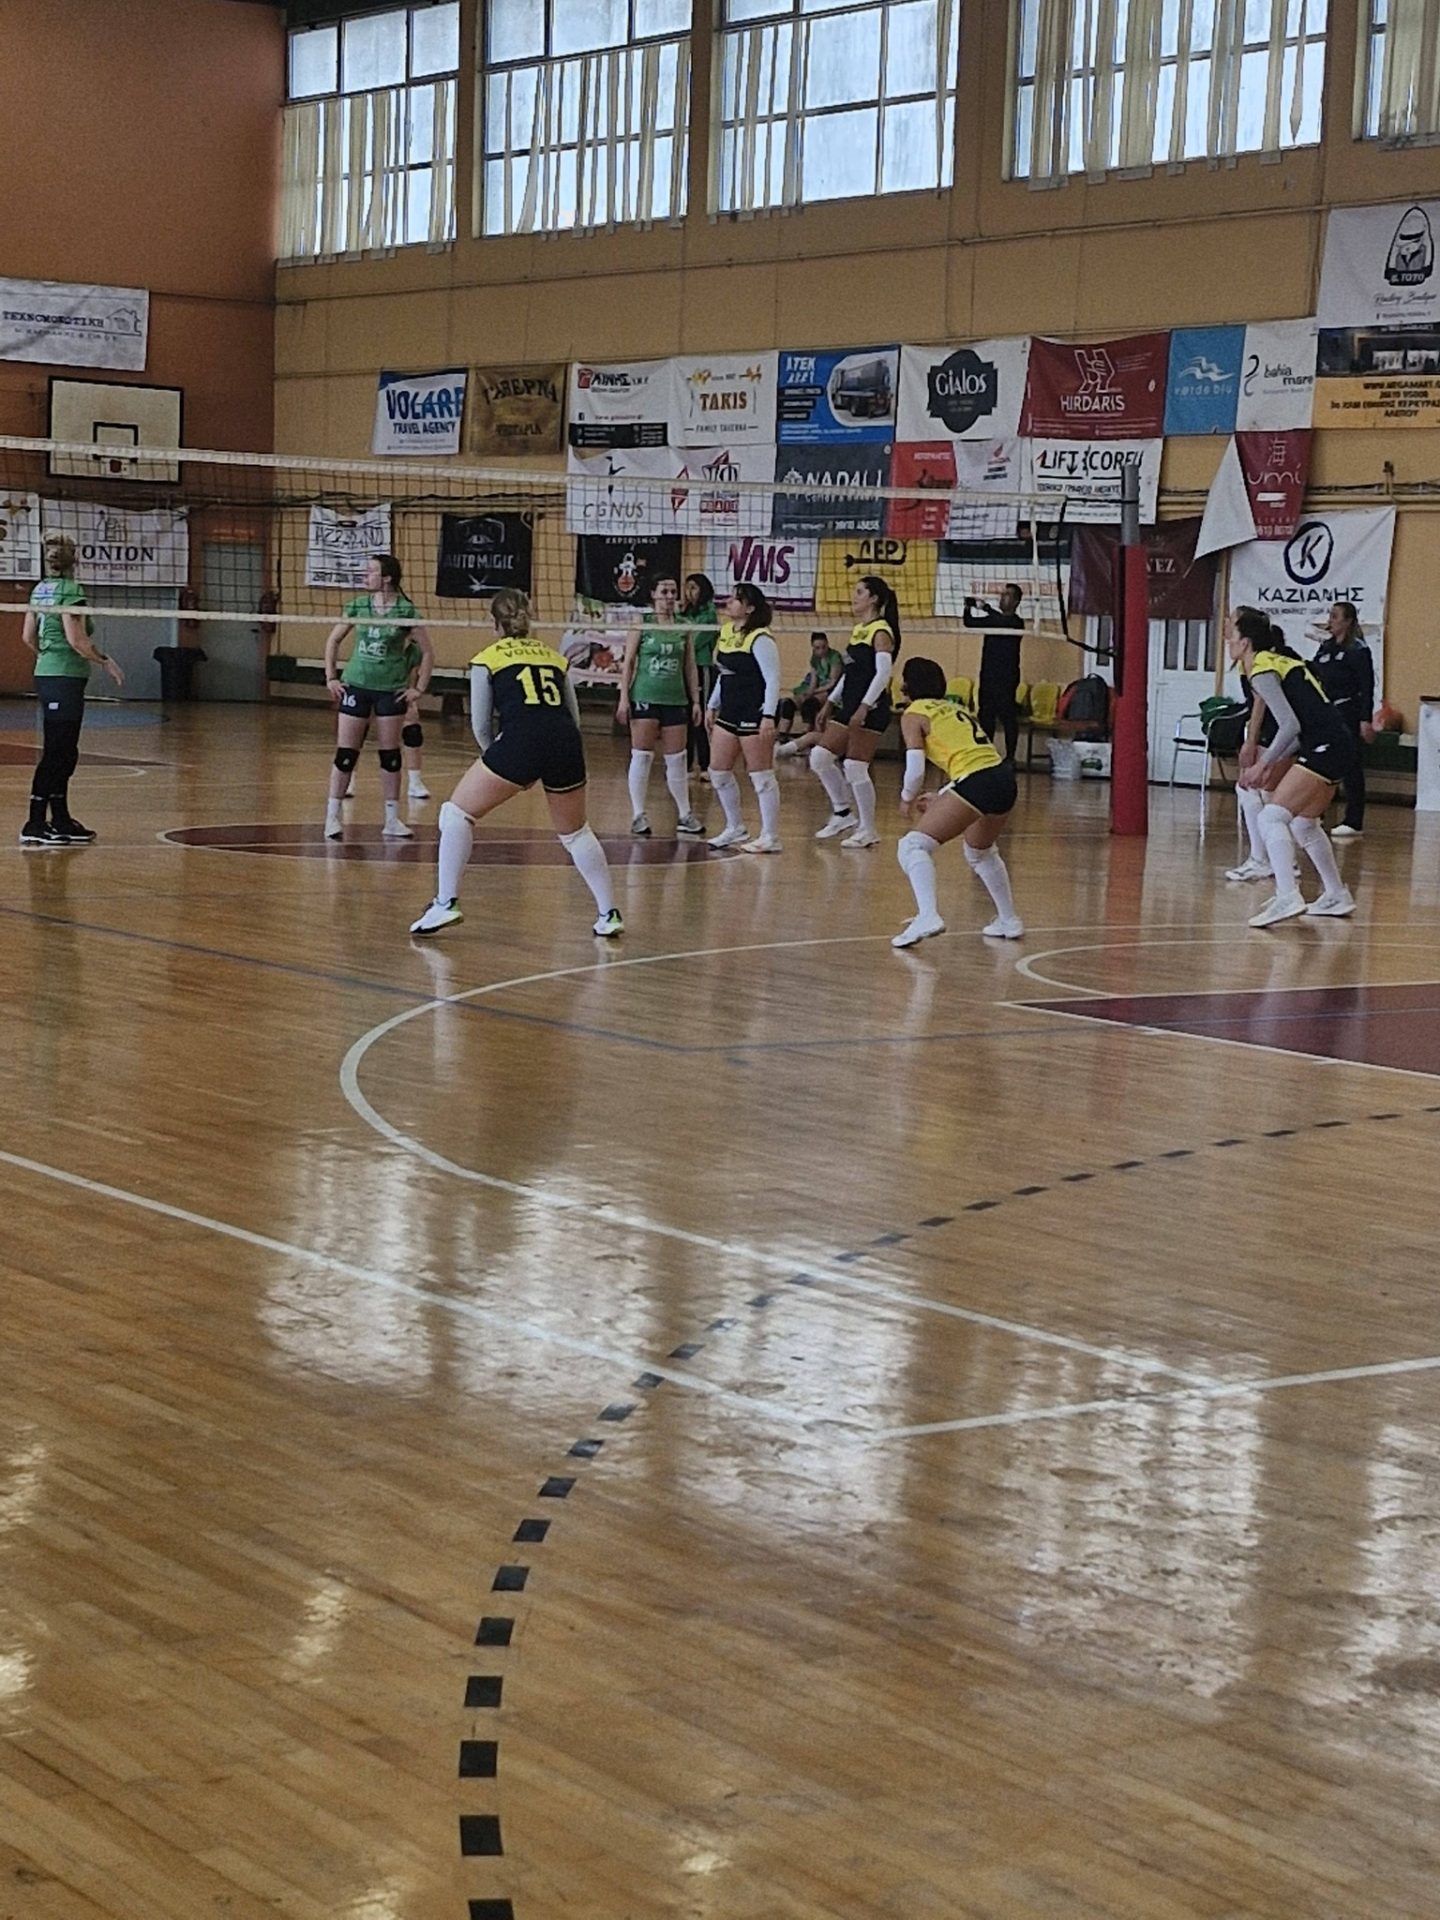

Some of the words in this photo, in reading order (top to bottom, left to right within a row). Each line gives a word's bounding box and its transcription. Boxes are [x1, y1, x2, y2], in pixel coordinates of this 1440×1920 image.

[700, 391, 747, 411] TAKIS
[1060, 395, 1125, 412] HIRDARIS
[81, 545, 154, 562] ONION
[1258, 587, 1364, 602] ΚΑΖΙΑΝΗΣ
[516, 666, 561, 706] 15
[342, 692, 357, 707] 16
